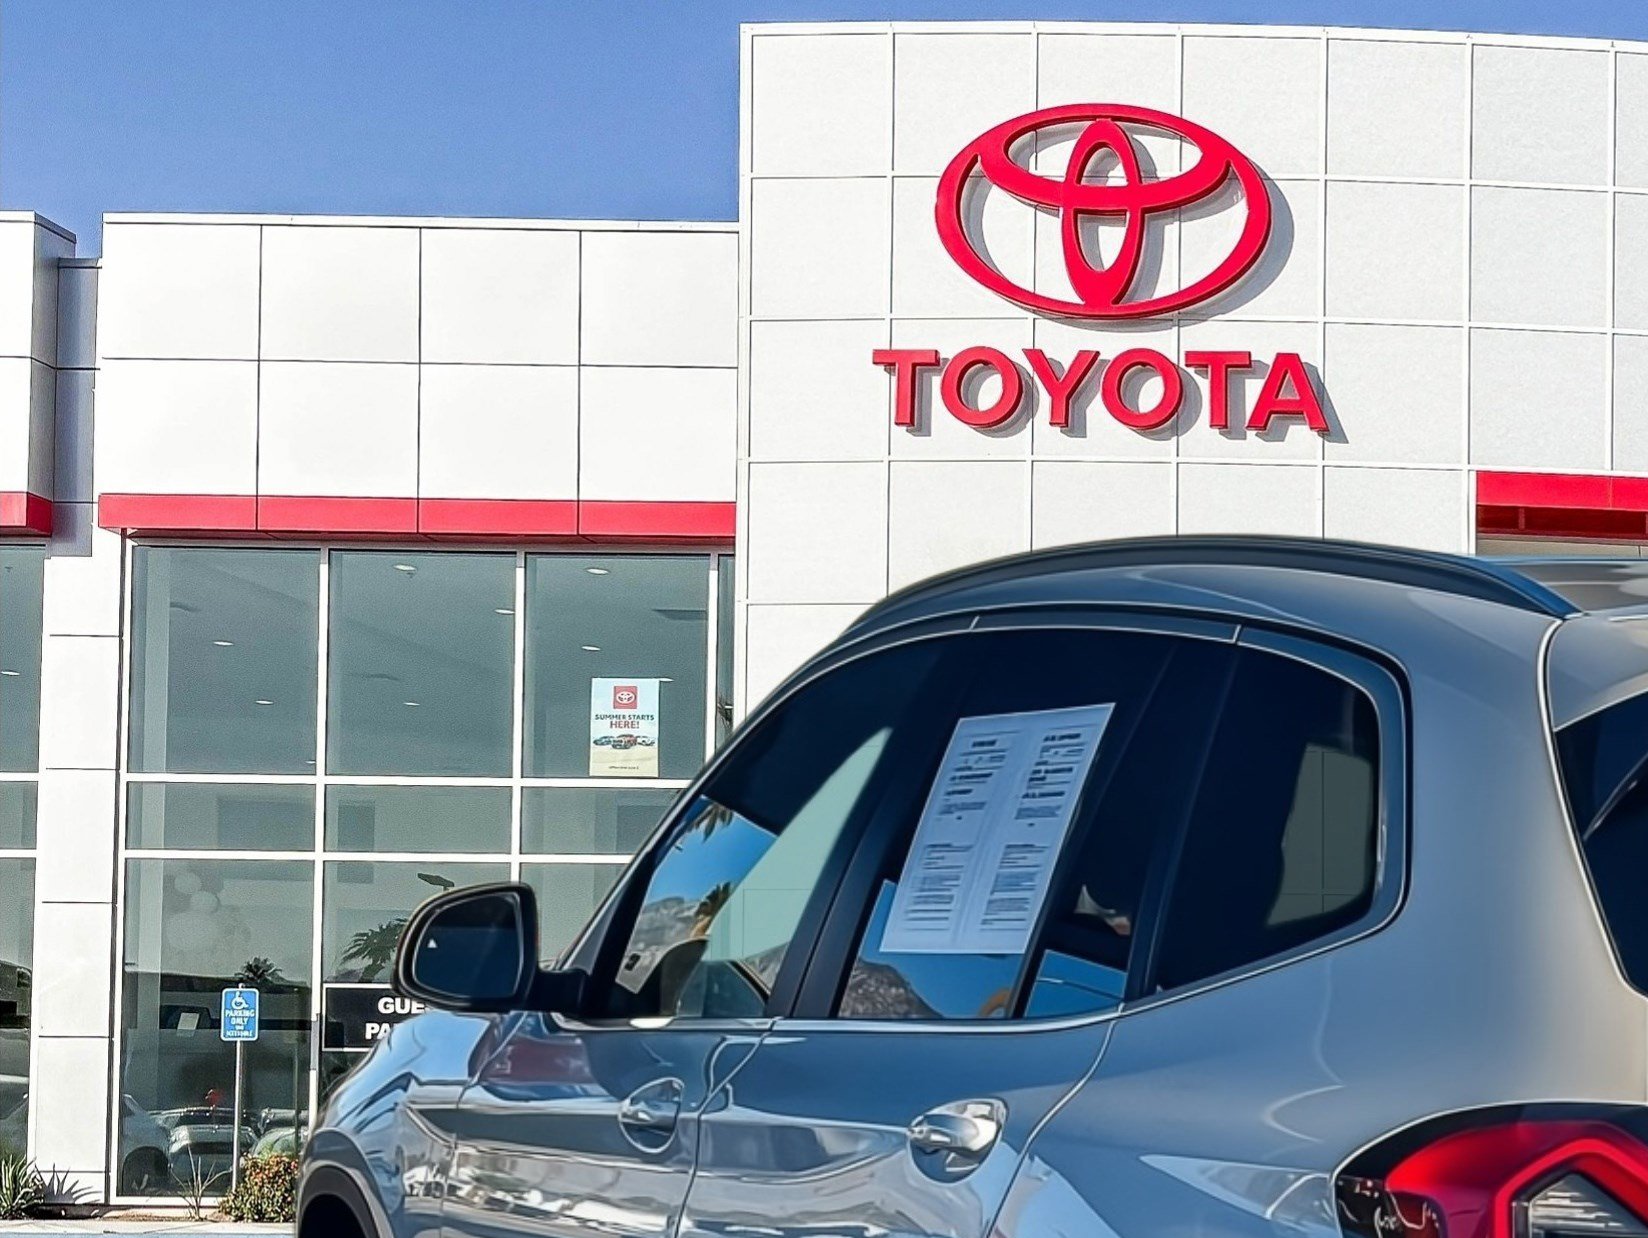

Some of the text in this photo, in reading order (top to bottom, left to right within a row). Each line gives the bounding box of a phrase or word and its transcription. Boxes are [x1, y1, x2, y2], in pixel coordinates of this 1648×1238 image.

[872, 345, 1330, 434] TOYOTA
[609, 720, 640, 729] HERE!
[377, 997, 427, 1015] GUE
[225, 1009, 255, 1017] PARKING
[230, 1017, 249, 1025] ONLY
